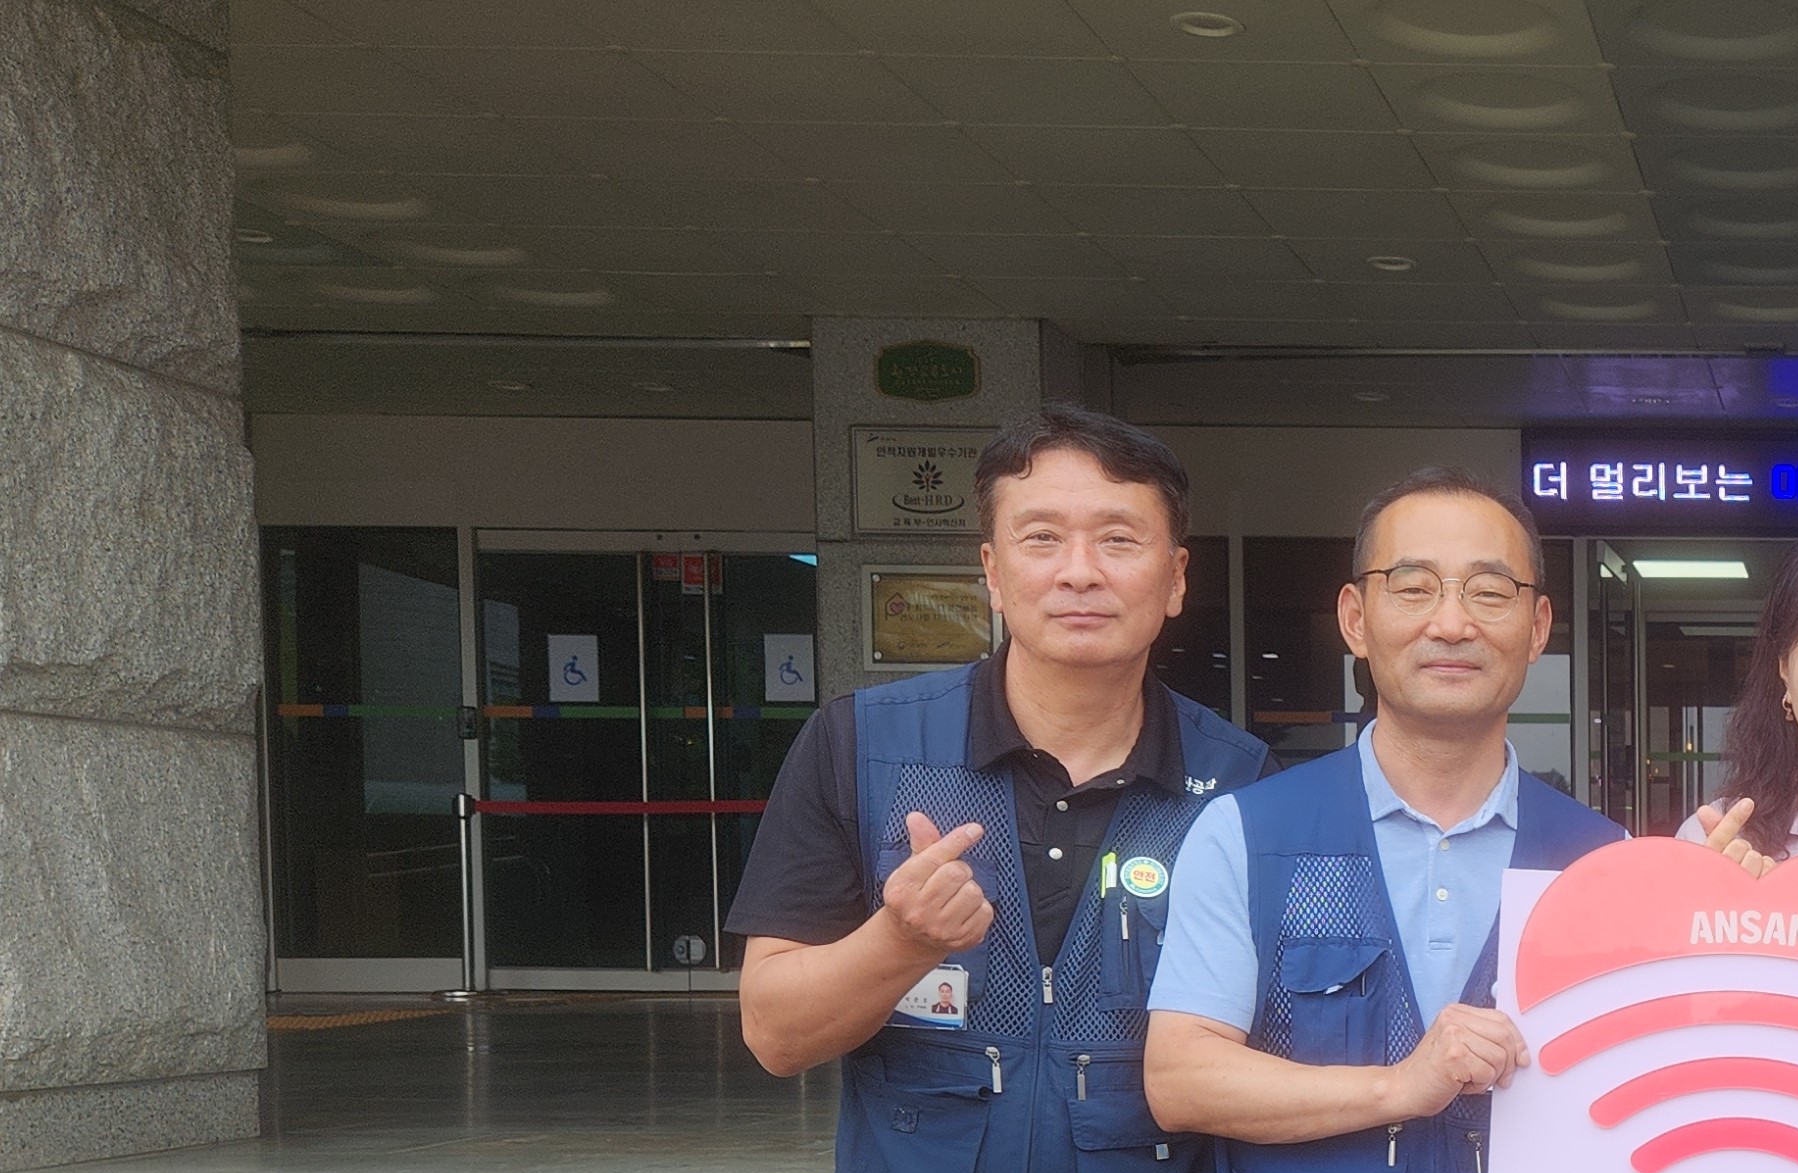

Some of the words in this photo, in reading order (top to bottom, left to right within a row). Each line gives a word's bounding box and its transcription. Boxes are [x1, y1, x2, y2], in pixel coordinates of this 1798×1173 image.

[1533, 462, 1567, 499] 더
[1589, 462, 1753, 501] 멀리보는
[1133, 870, 1156, 883] 안전
